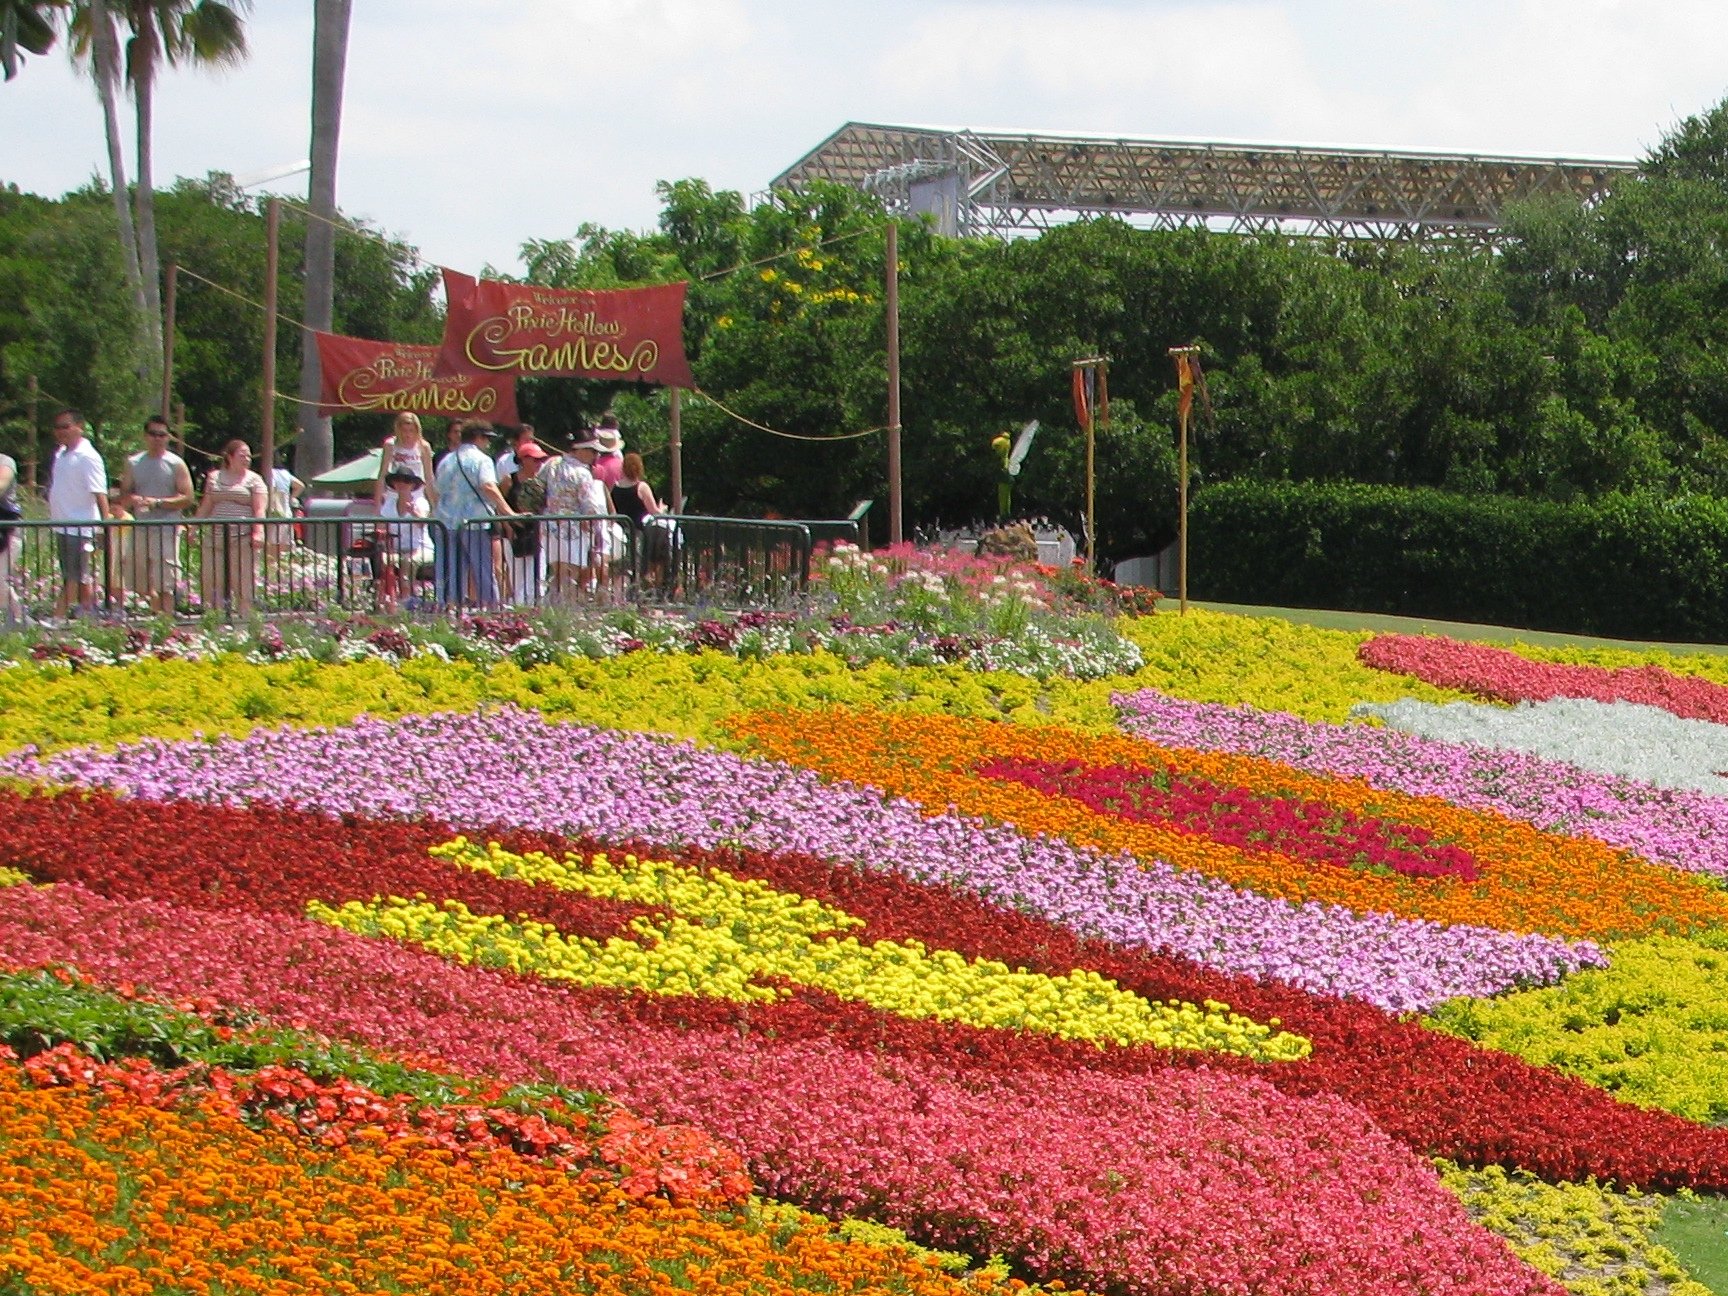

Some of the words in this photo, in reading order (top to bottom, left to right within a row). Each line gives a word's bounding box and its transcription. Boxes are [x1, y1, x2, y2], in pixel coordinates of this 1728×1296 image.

[507, 301, 558, 333] Pixie
[546, 307, 628, 338] Hollow
[465, 317, 659, 373] Games
[338, 368, 497, 413] Games
